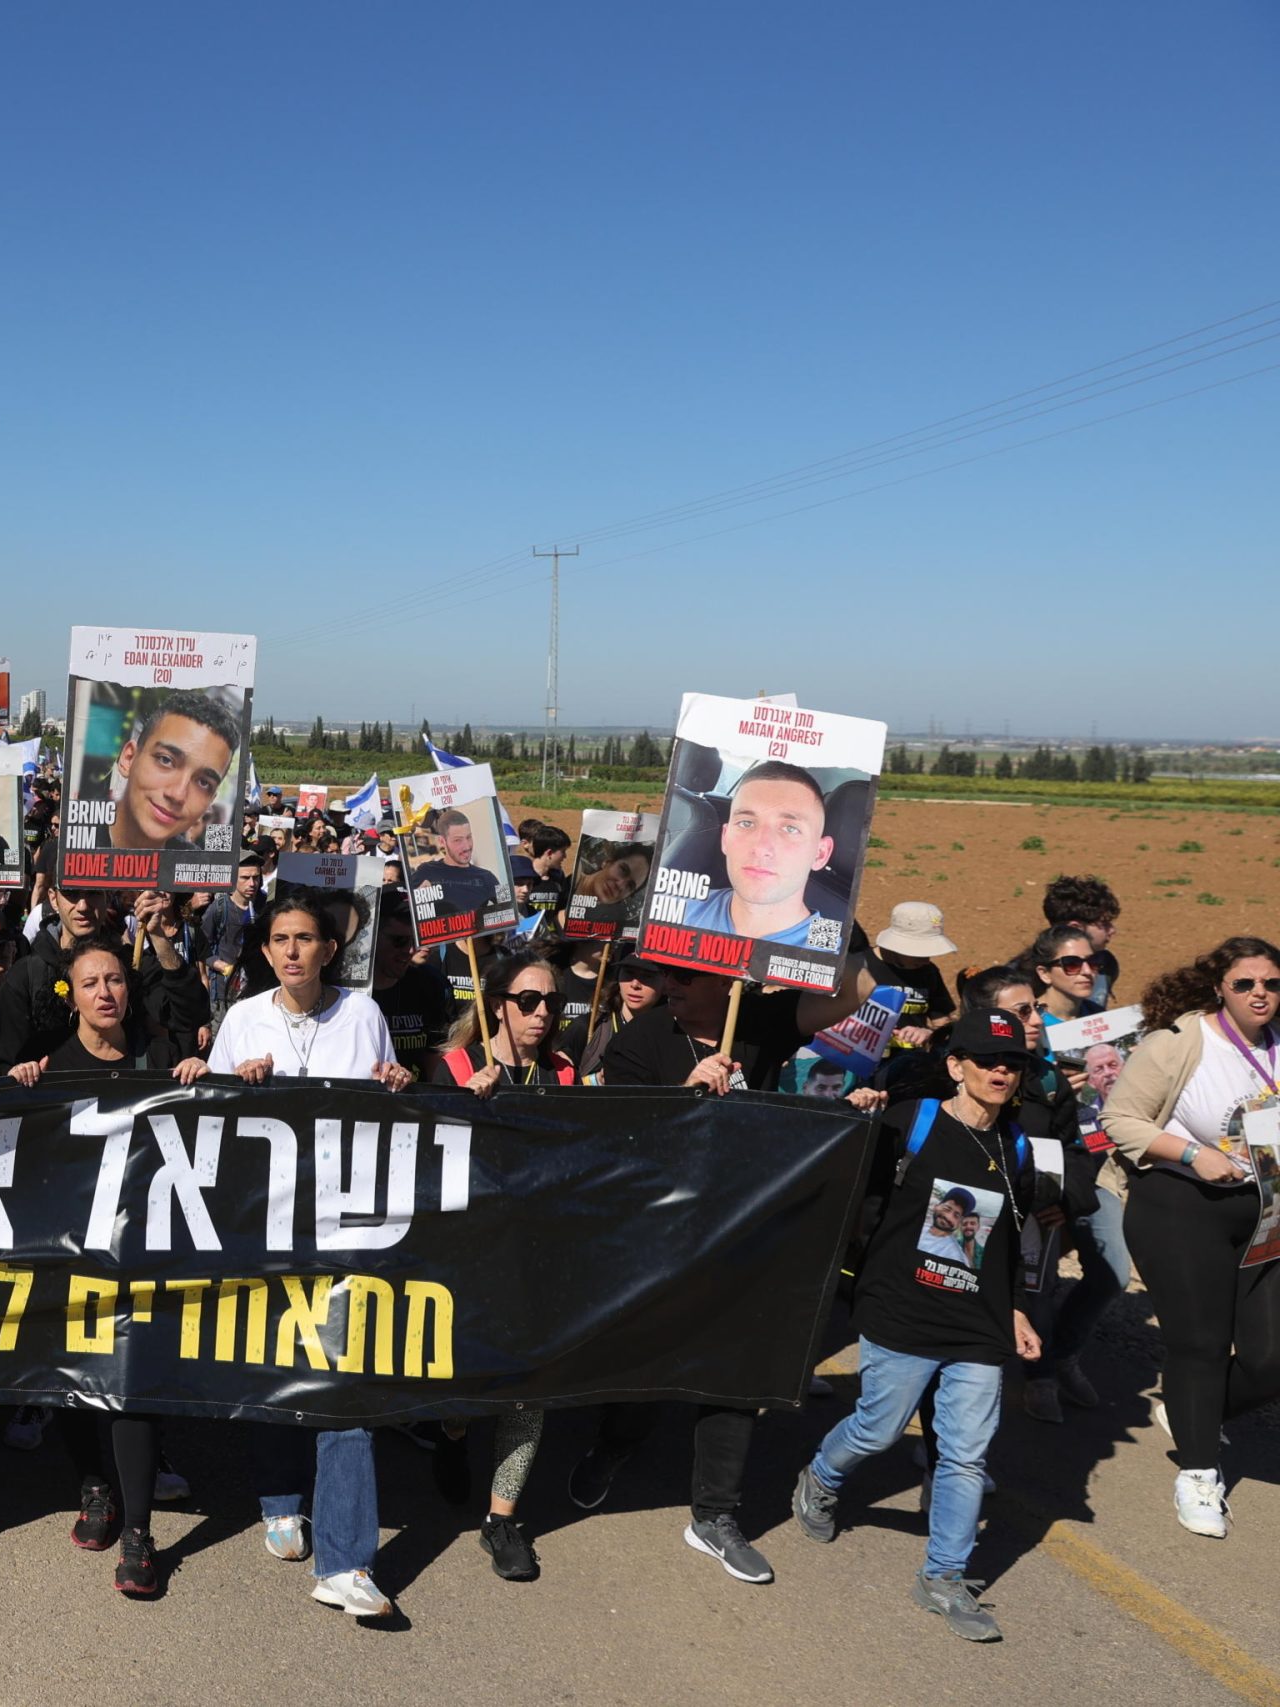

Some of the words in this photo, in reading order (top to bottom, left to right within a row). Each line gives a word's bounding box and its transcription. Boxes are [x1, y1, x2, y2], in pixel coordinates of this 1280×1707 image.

[135, 636, 173, 650] אלכסנדר
[176, 637, 195, 651] עידן
[124, 652, 149, 665] EDAN
[151, 652, 203, 668] ALEXANDER
[153, 669, 172, 684] (20)
[754, 706, 791, 724] אנגרסט
[794, 713, 814, 728] מתן
[739, 721, 774, 738] MATAN
[777, 727, 824, 746] ANGREST
[768, 742, 788, 758] (21)
[431, 786, 444, 797] ITAY
[444, 783, 458, 795] CHEN
[68, 800, 116, 826] BRING
[67, 826, 97, 849] HIM
[65, 853, 109, 876] HOME
[113, 852, 159, 878] NOW!
[314, 867, 335, 875] CARMEL
[175, 871, 205, 883] FAMILIES
[207, 872, 231, 884] FORUM
[654, 868, 710, 900] BRING
[414, 885, 444, 904] BRING
[571, 895, 598, 908] BRING
[416, 903, 436, 920] HIM
[569, 907, 585, 919] HER
[649, 894, 687, 924] HIM
[420, 918, 447, 937] HOME
[448, 909, 476, 929] NOW!
[567, 921, 591, 932] HOME
[592, 922, 617, 934] NOW!
[644, 924, 694, 951] HOME
[698, 933, 752, 968] NOW!
[770, 954, 797, 967] HOSTAGES
[798, 960, 810, 969] AND
[810, 962, 836, 976] MISSING
[768, 964, 804, 982] FAMILIES
[806, 972, 834, 988] FORUM
[70, 1097, 472, 1251] ישראל
[66, 1274, 454, 1379] מתאחדים
